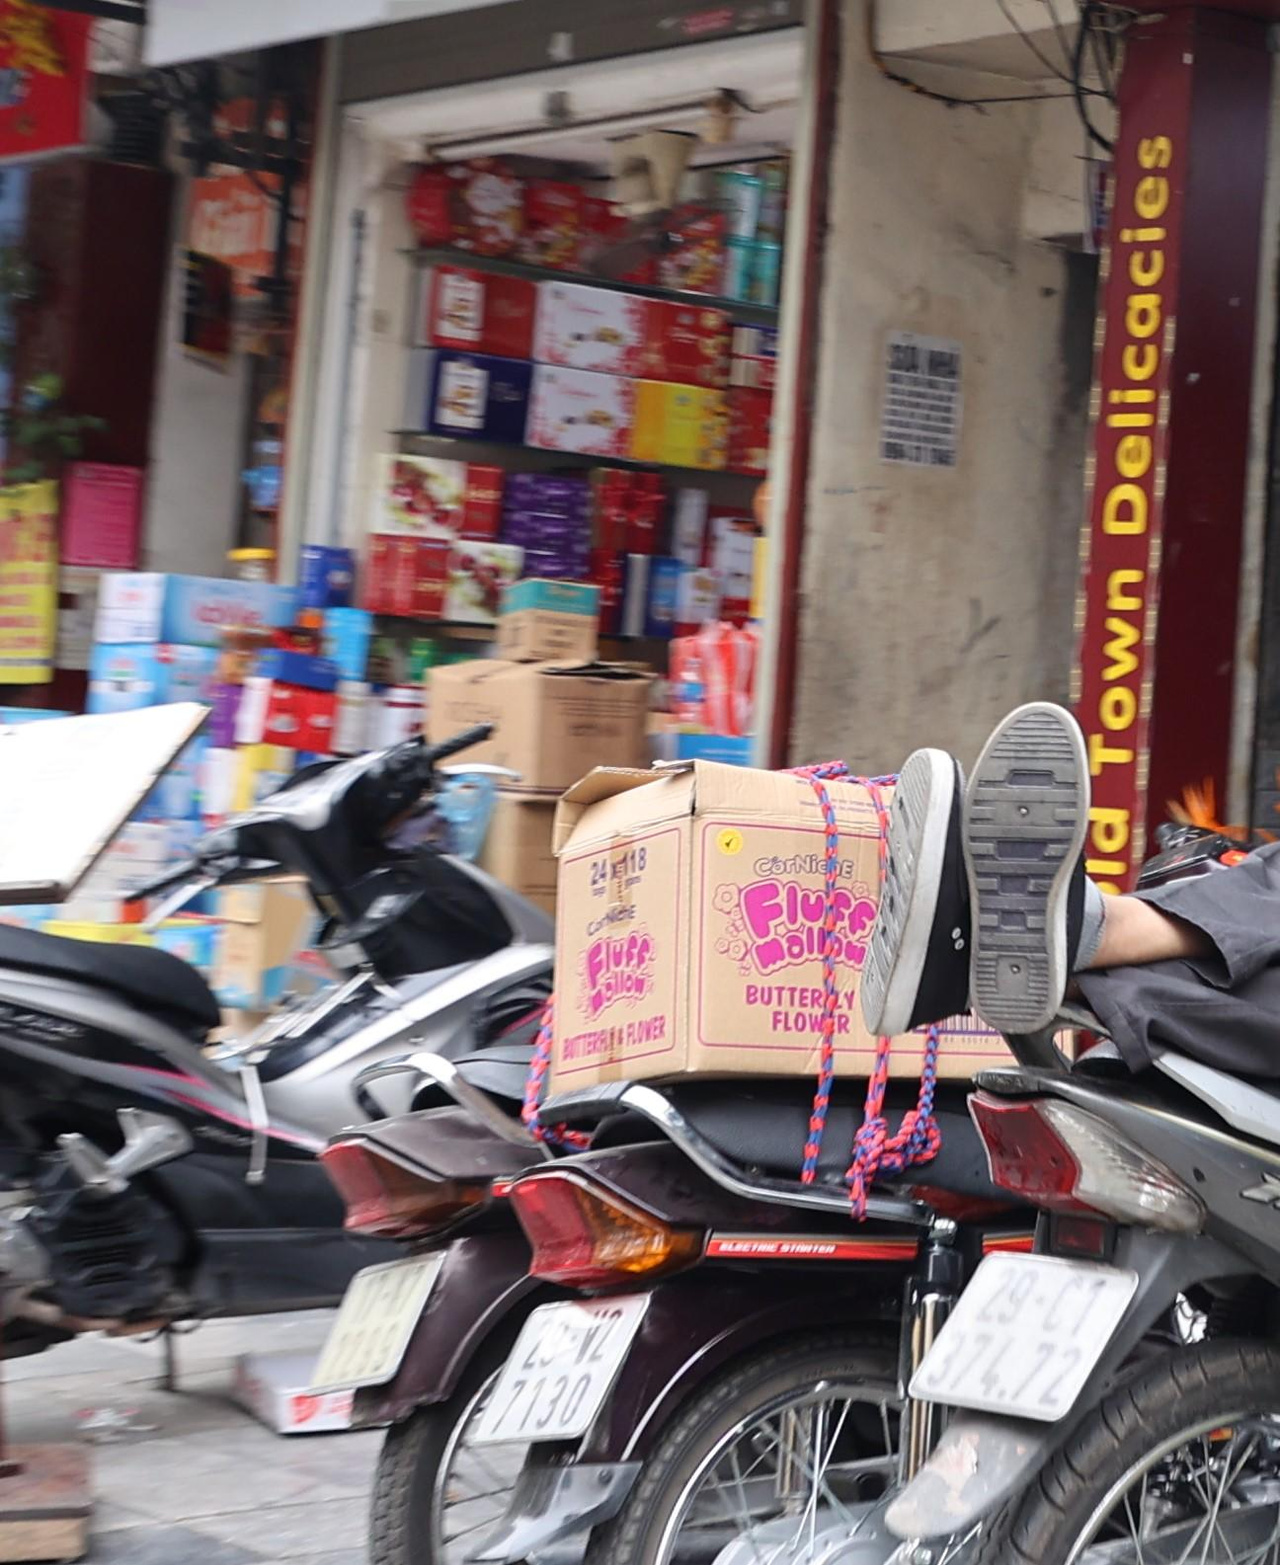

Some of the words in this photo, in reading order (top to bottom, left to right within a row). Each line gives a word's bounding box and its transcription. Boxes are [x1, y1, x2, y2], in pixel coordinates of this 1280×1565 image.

[1102, 135, 1173, 535] Delicacies
[1089, 569, 1145, 777] Town
[591, 859, 607, 885] 24
[625, 1015, 666, 1047] FLOWER
[771, 1011, 850, 1034] FLOWR
[719, 1242, 778, 1253] ELECTRIC
[492, 1374, 592, 1435] 7130
